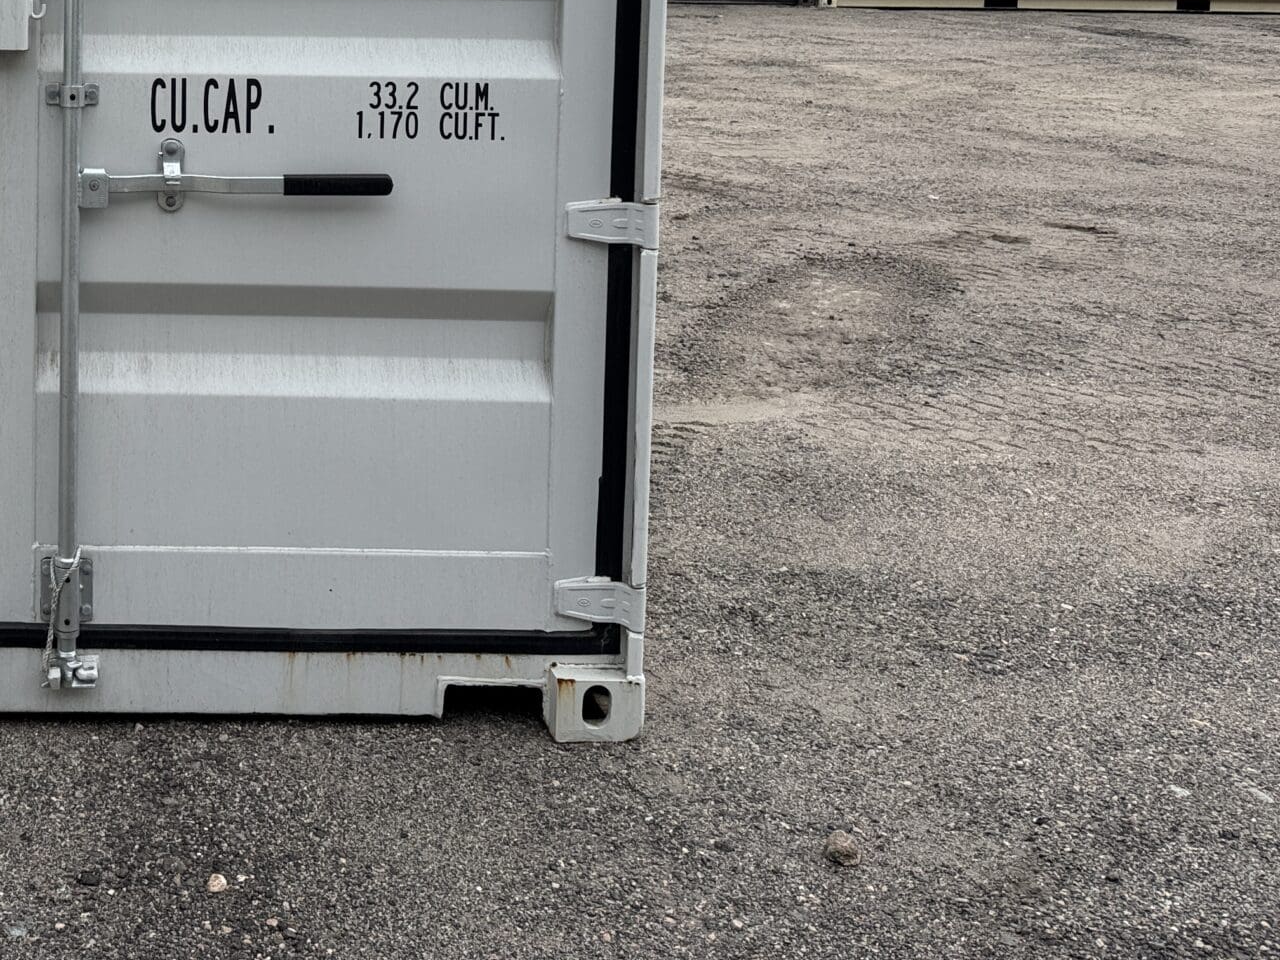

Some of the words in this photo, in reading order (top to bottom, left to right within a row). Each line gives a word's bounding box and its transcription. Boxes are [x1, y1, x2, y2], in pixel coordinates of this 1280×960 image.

[150, 77, 275, 134] CU.CAP.
[369, 81, 419, 110] 33.2
[439, 82, 495, 111] CU.M.
[356, 111, 419, 139] 1,170
[439, 112, 505, 141] CU.FT.
